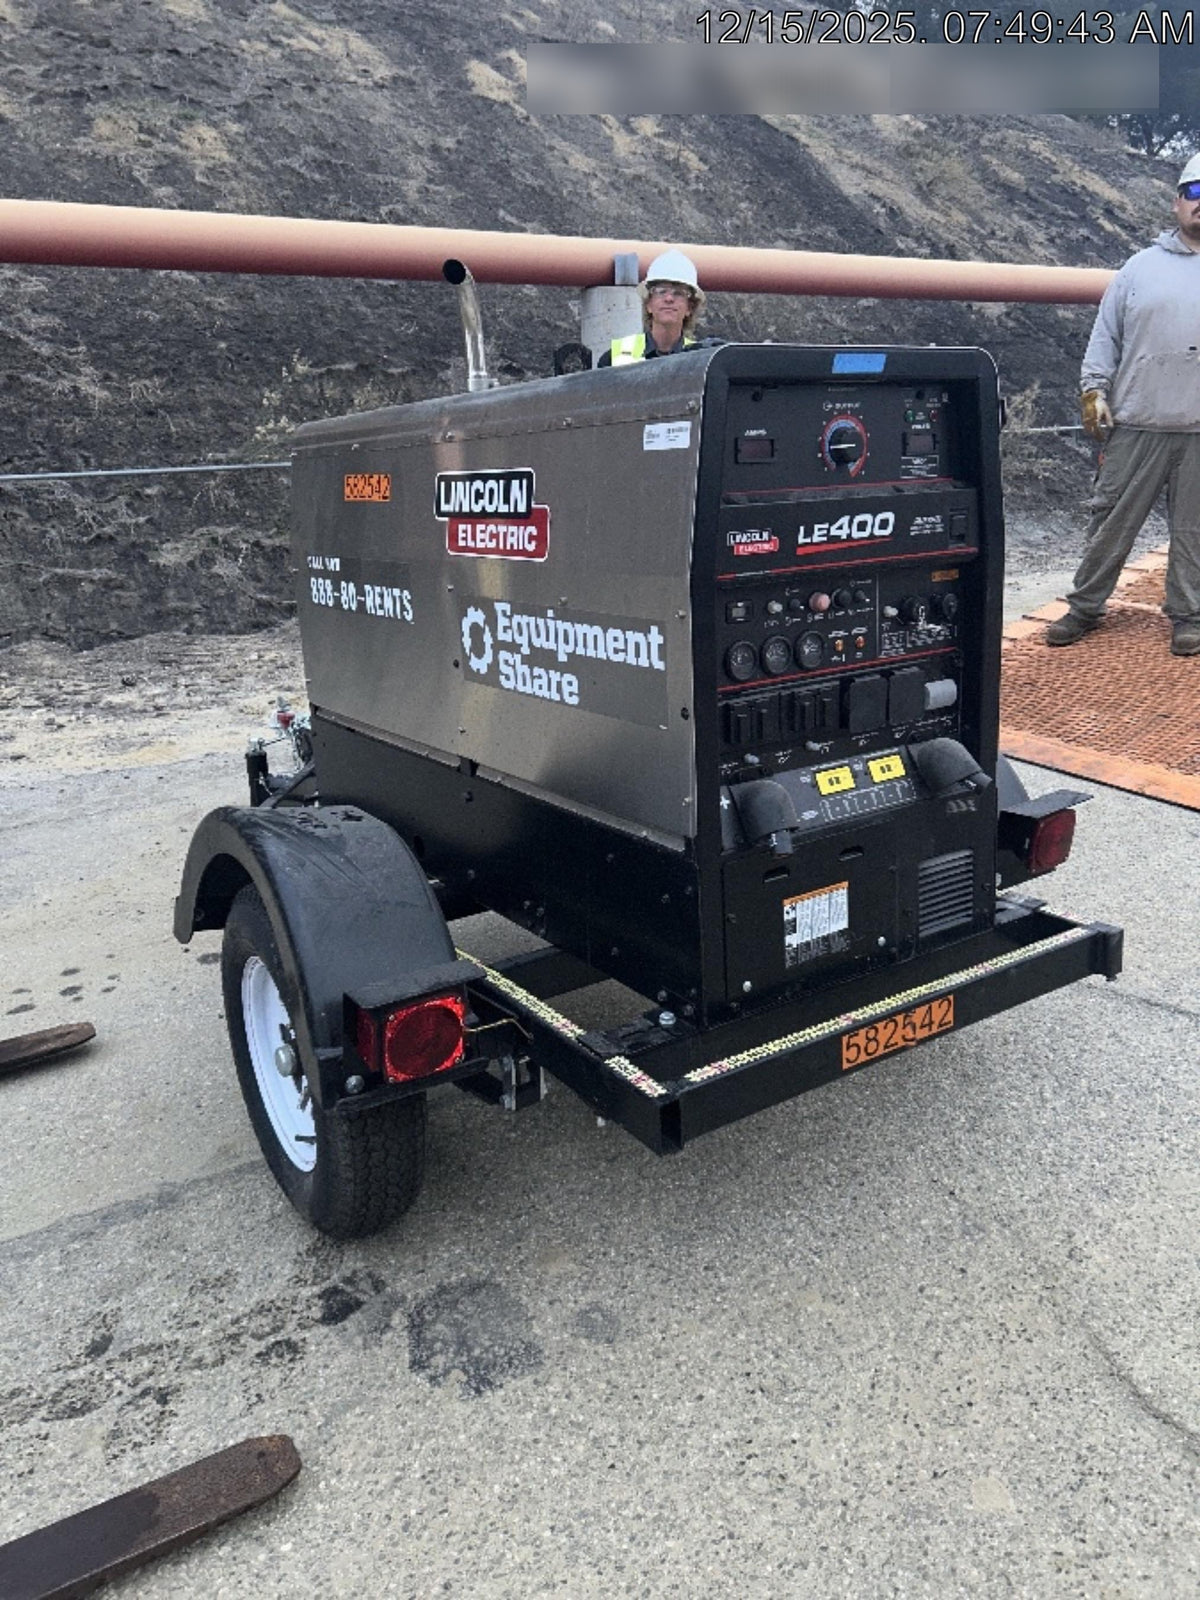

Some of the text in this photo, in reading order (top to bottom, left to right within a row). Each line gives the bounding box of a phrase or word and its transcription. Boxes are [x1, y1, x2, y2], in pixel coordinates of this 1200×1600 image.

[345, 473, 390, 500] 582542
[440, 477, 529, 514] LINCOLN
[457, 523, 538, 552] ELECTRIC
[730, 531, 769, 545] LINCOLN
[797, 510, 896, 545] LE400
[310, 576, 414, 622] 888-80-RENTS
[494, 601, 666, 671] Equipment
[498, 650, 580, 706] Share
[845, 997, 953, 1065] 582542
